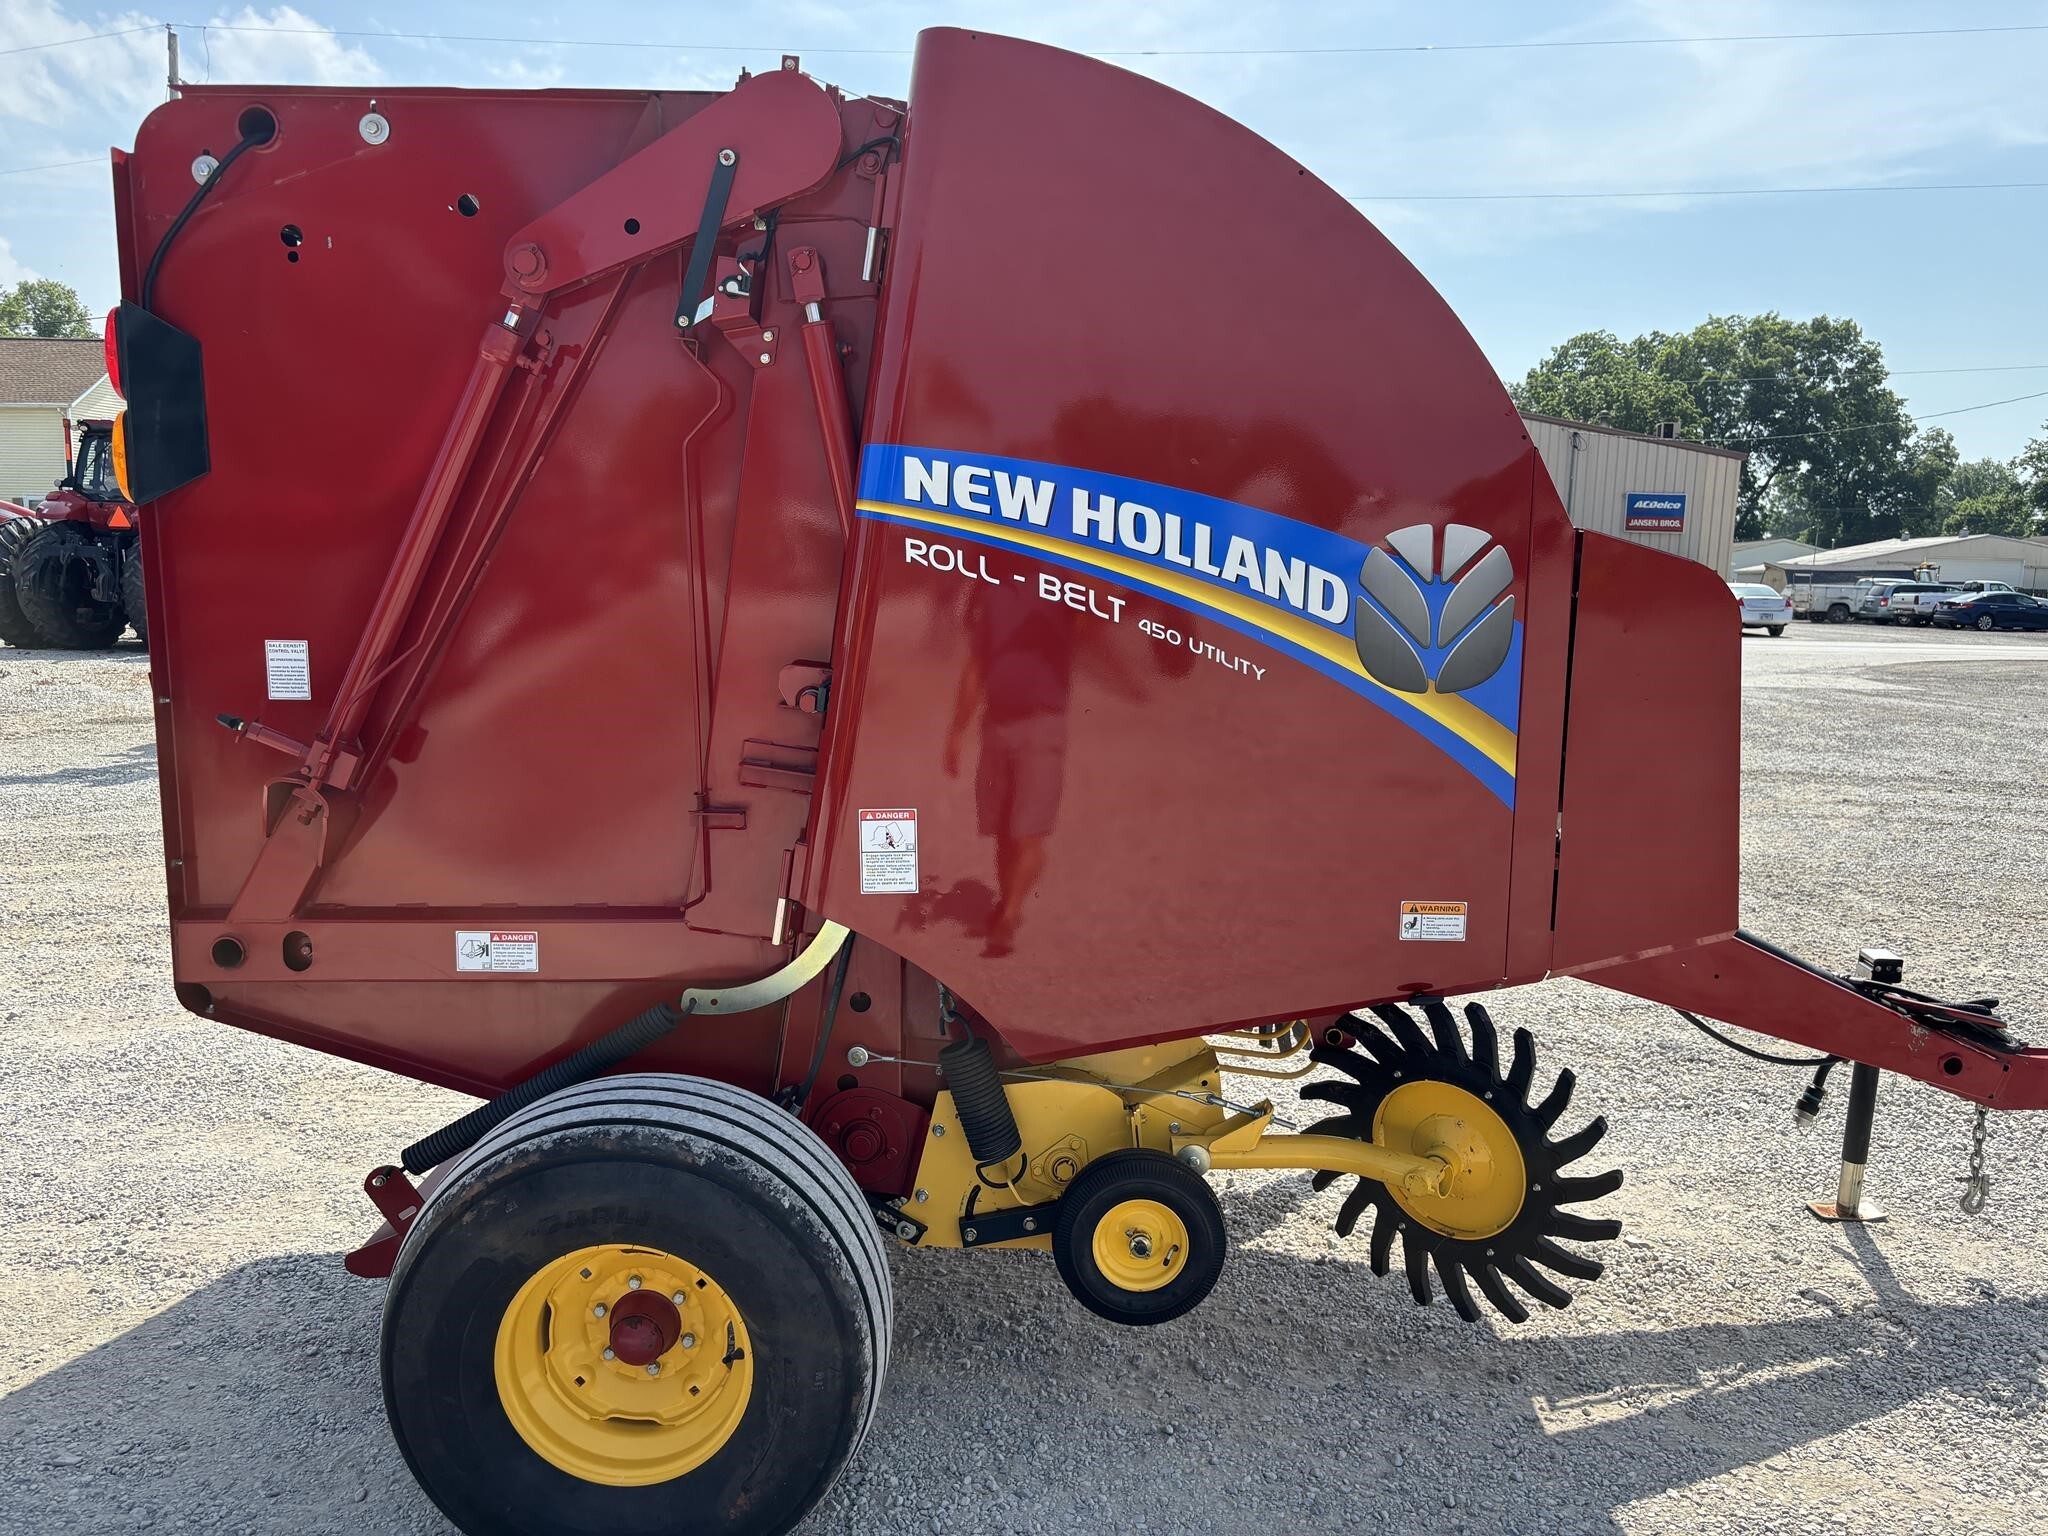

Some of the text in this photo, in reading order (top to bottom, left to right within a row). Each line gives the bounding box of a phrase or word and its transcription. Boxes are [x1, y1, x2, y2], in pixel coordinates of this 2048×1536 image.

[904, 456, 1349, 624] NEW HOLLAND
[1634, 501, 1681, 509] ACDelco
[905, 537, 1000, 585] ROLL
[1039, 572, 1126, 623] BELT
[1138, 618, 1182, 646] 450
[1189, 637, 1267, 681] UTILITY
